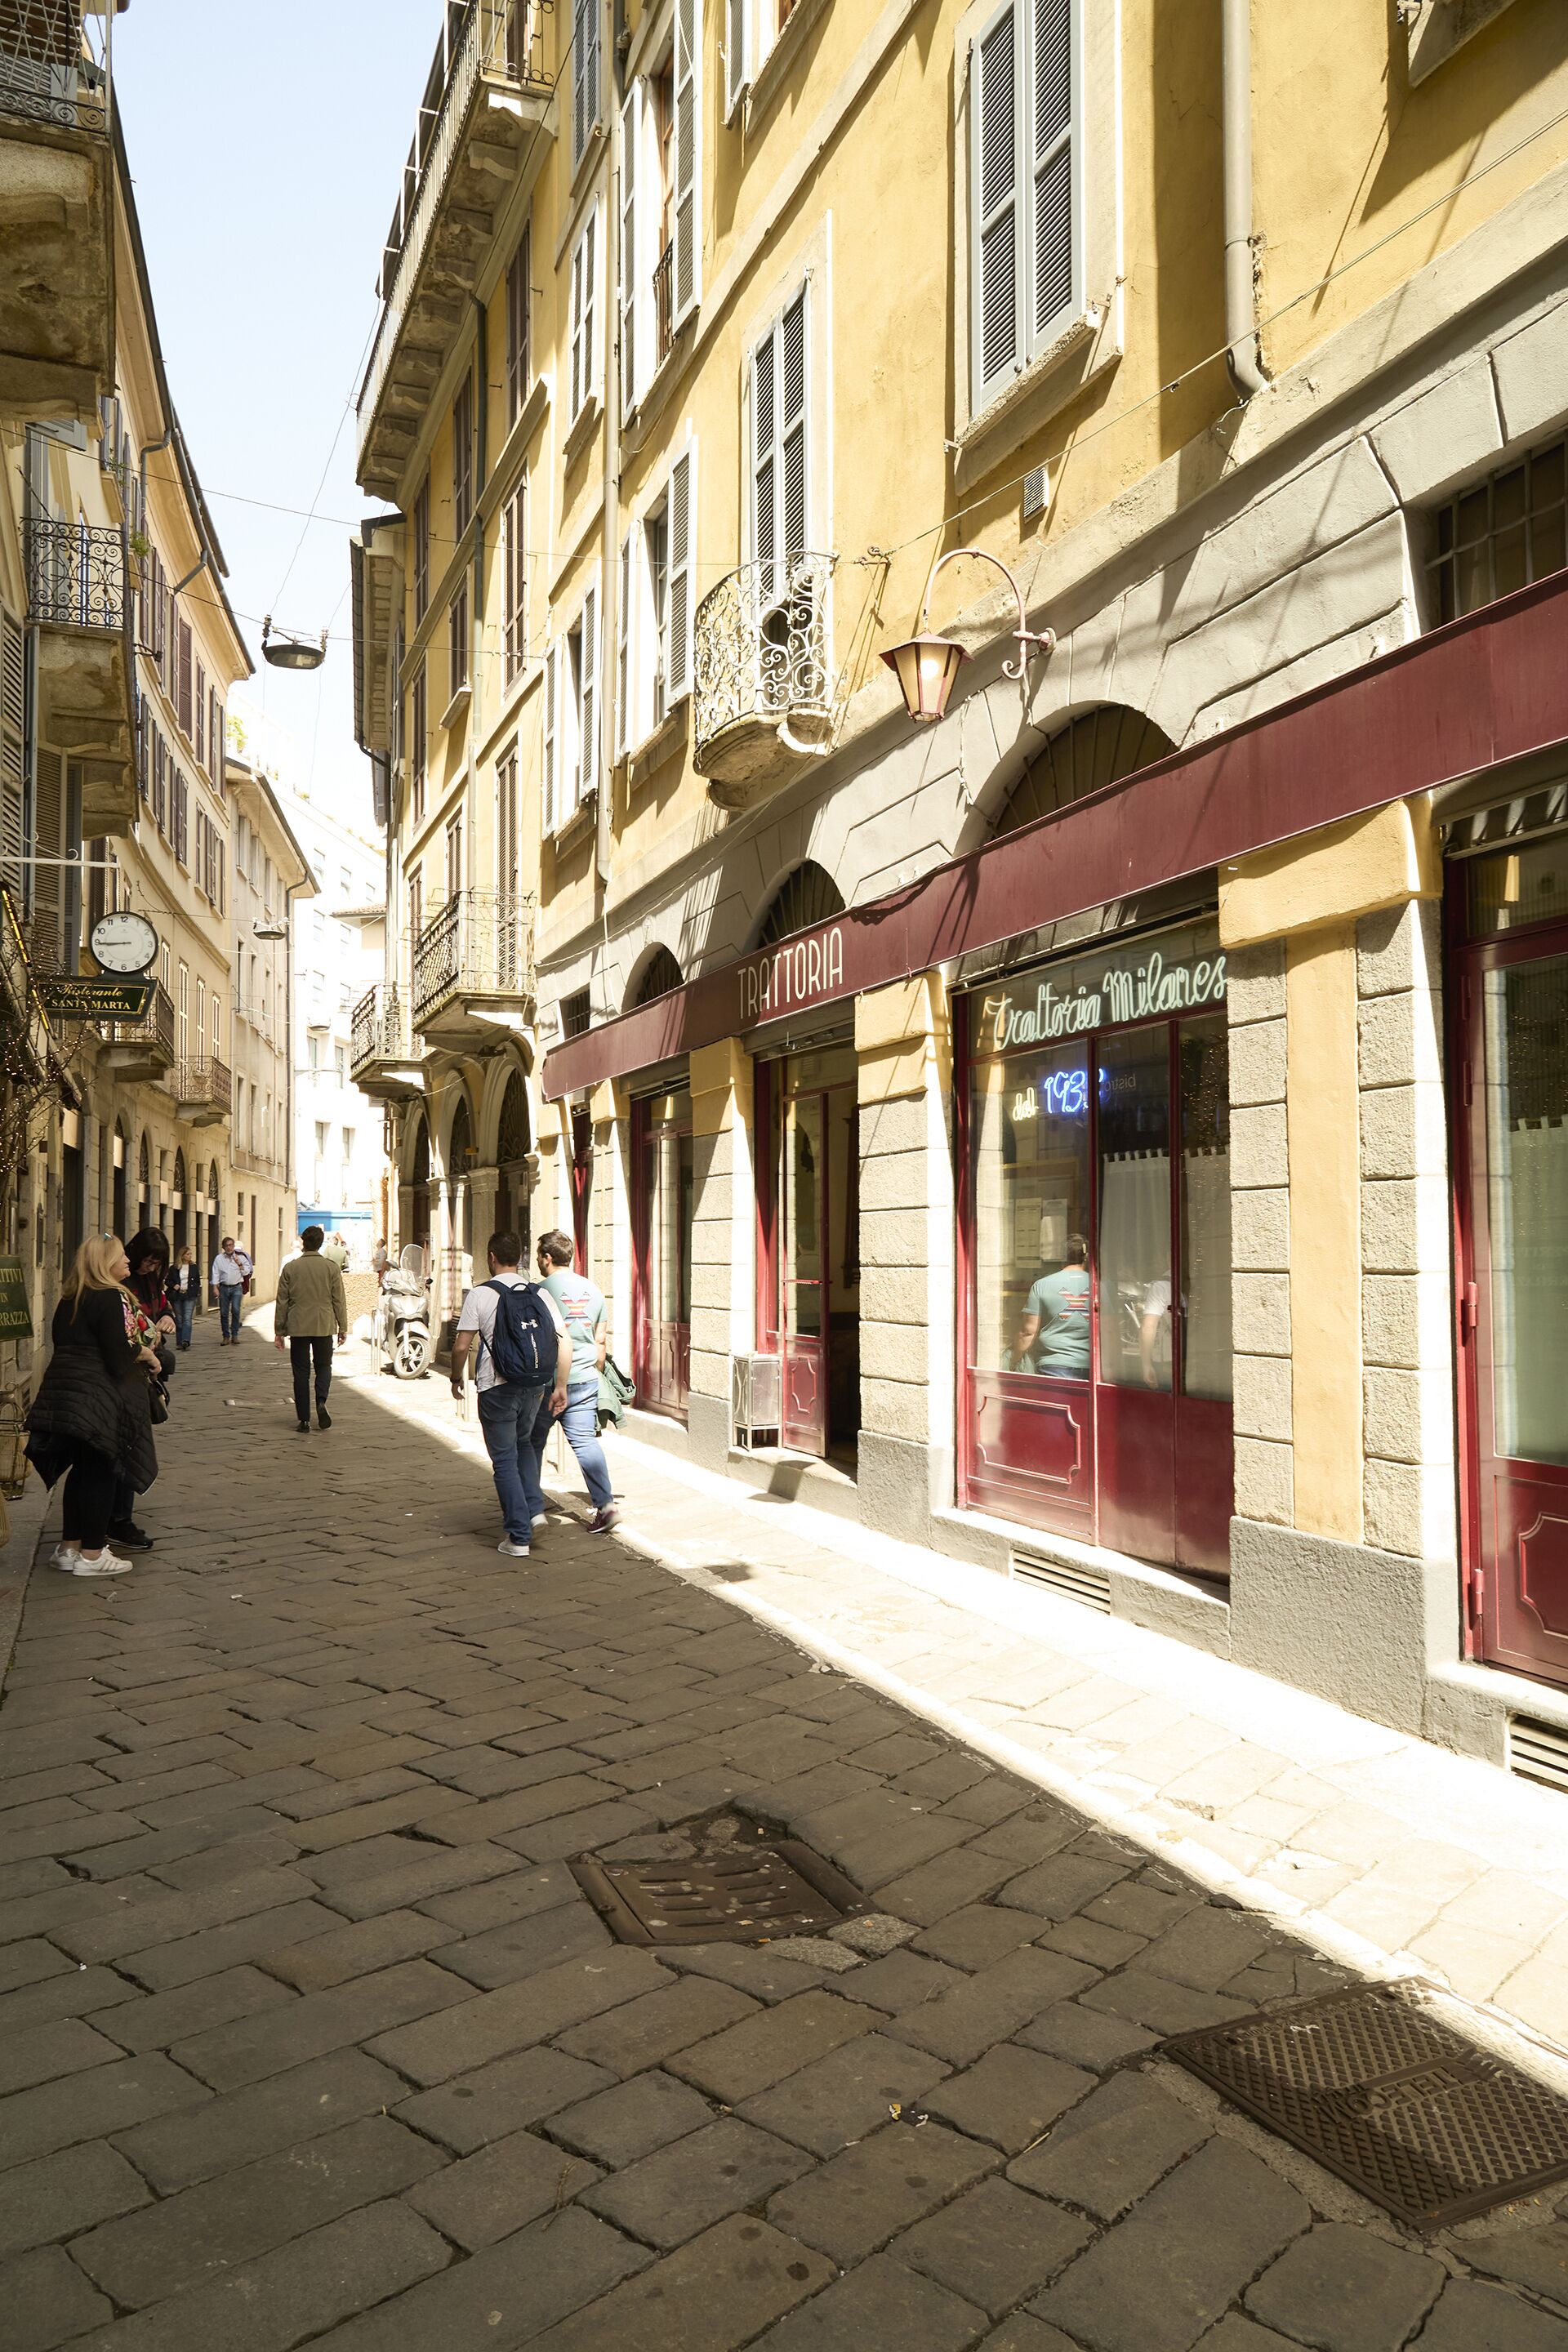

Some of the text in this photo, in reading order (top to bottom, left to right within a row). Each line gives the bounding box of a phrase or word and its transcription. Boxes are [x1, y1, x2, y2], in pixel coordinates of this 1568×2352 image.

[96, 927, 105, 935] 10
[737, 927, 843, 1019] TRATTORIA
[60, 983, 124, 997] Ristorante
[985, 951, 1227, 1050] Trattoria Milanes
[51, 999, 131, 1010] SANTA MARTA
[1013, 1087, 1039, 1121] dal
[0, 1268, 23, 1282] ITIVI
[1316, 2065, 1463, 2124] TELECOM
